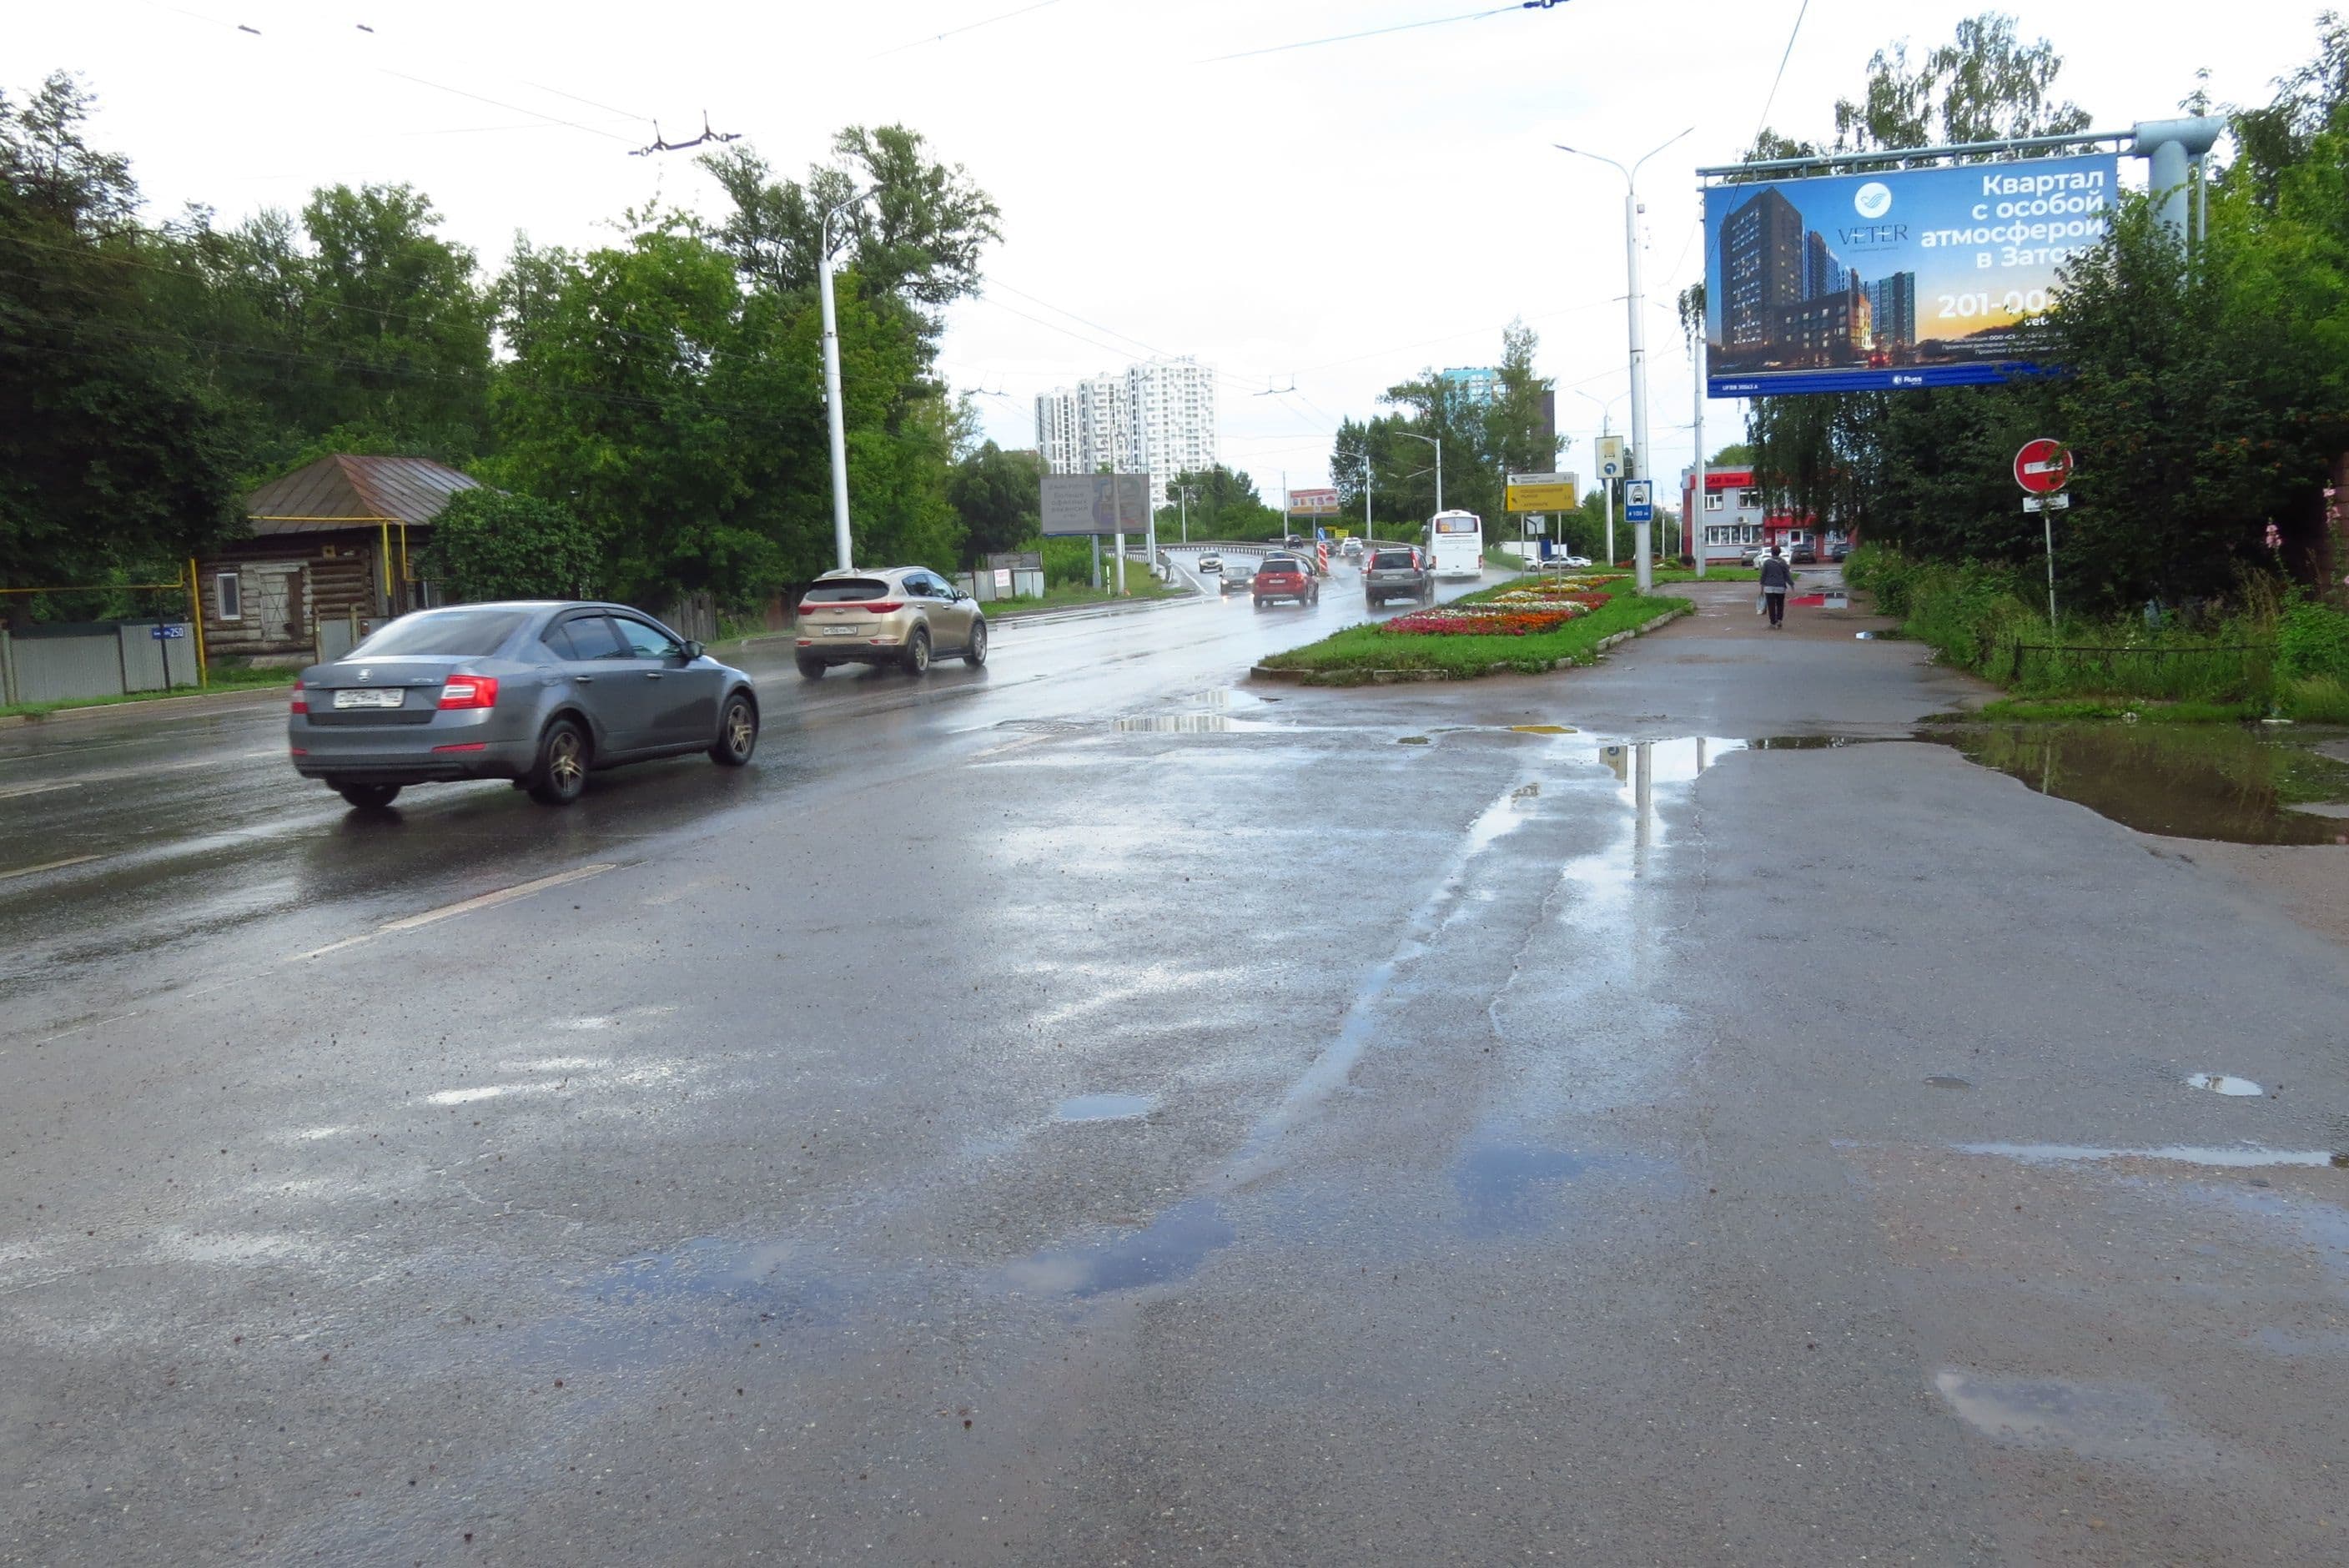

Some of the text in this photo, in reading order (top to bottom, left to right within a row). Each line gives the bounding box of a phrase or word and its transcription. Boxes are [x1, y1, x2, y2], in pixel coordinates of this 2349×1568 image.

[1982, 170, 2104, 197] Квартал
[1972, 189, 2104, 220] с особой
[1838, 224, 1909, 245] VETER
[1921, 217, 2103, 248] атмосферой
[1976, 252, 1992, 269] в
[170, 627, 184, 637] 250
